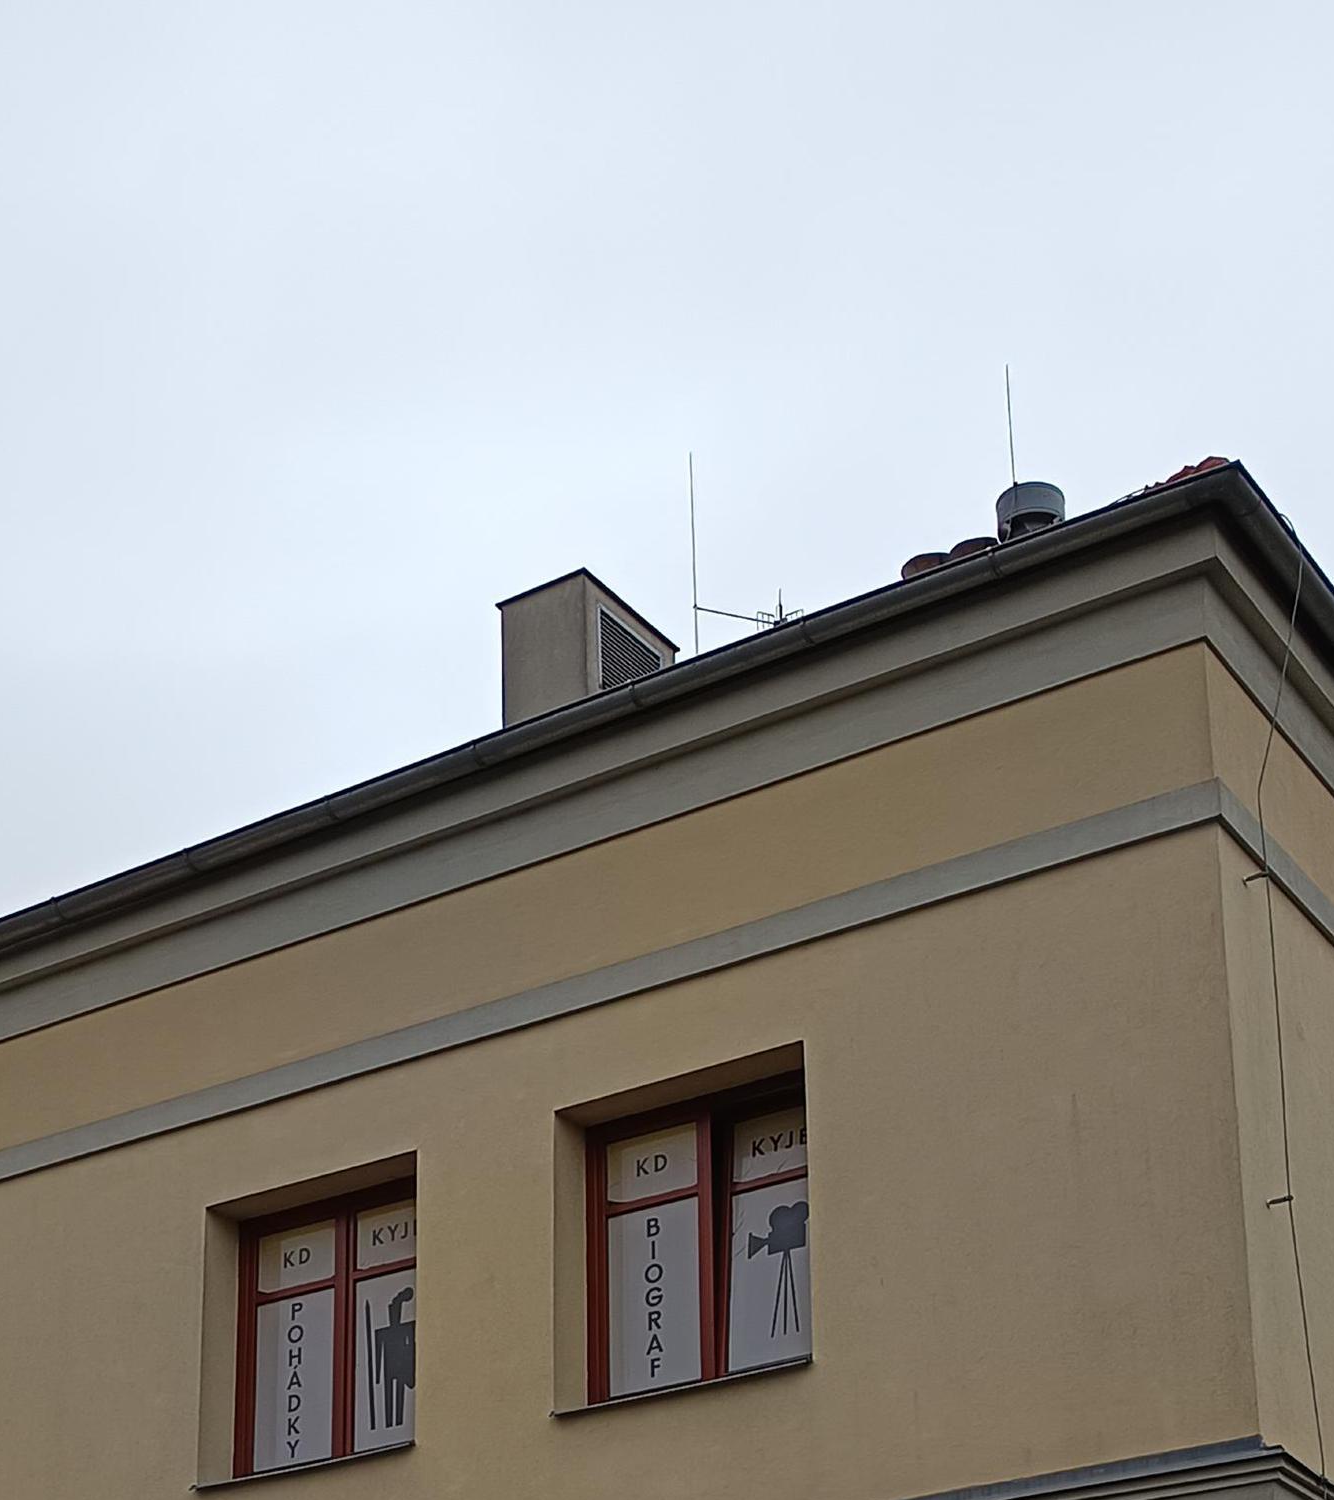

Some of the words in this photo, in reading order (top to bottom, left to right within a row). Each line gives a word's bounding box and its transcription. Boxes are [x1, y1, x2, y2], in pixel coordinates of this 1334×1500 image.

[636, 1154, 668, 1177] KD
[283, 1247, 311, 1269] KD
[371, 1219, 417, 1247] KYJ
[643, 1217, 664, 1379] BIOGRAF
[286, 1302, 305, 1459] POHÁDKY
